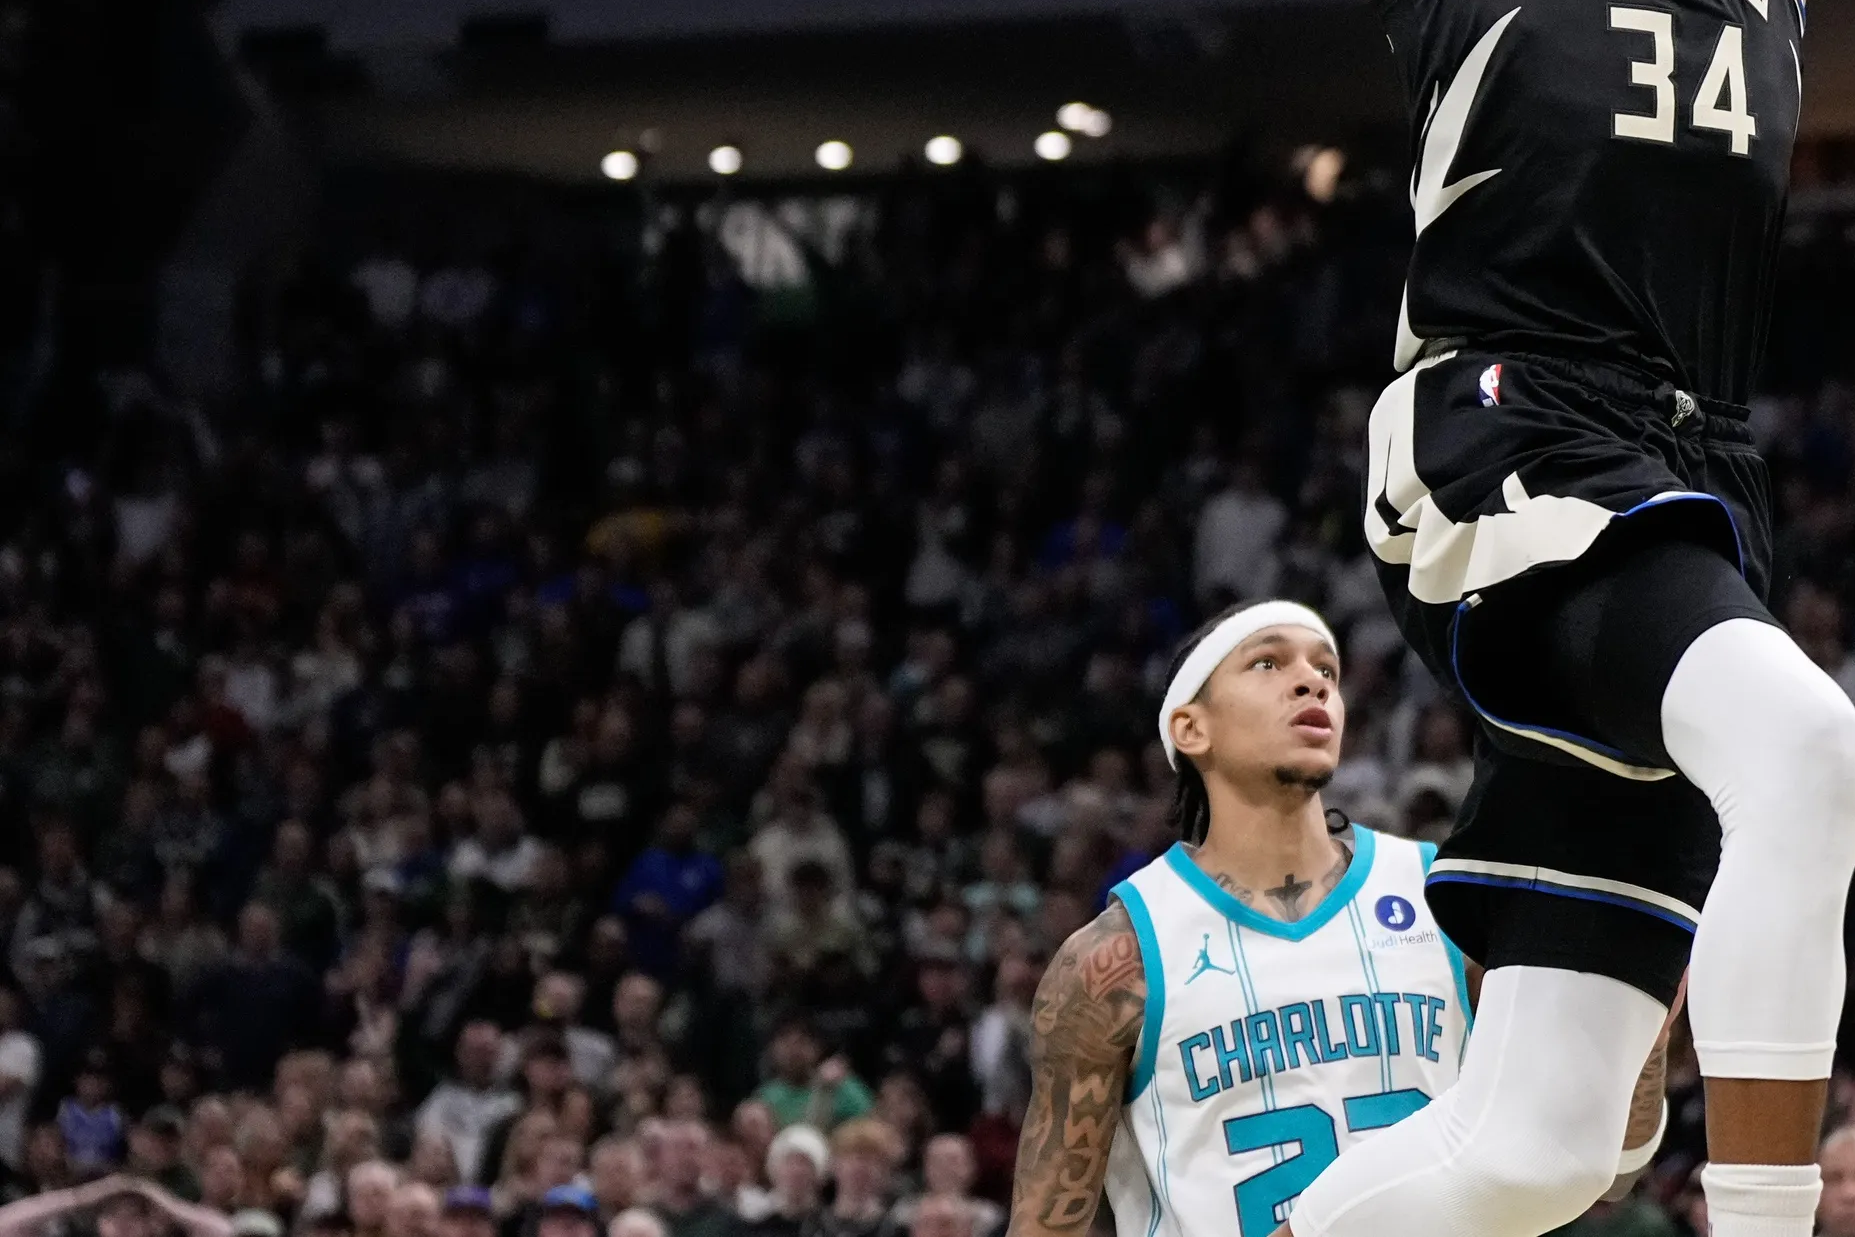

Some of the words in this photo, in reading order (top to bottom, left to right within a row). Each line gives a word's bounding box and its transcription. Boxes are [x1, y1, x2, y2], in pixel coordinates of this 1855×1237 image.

[1607, 3, 1757, 157] 34
[1399, 929, 1438, 945] Health
[1177, 992, 1446, 1102] CHARLOTTE
